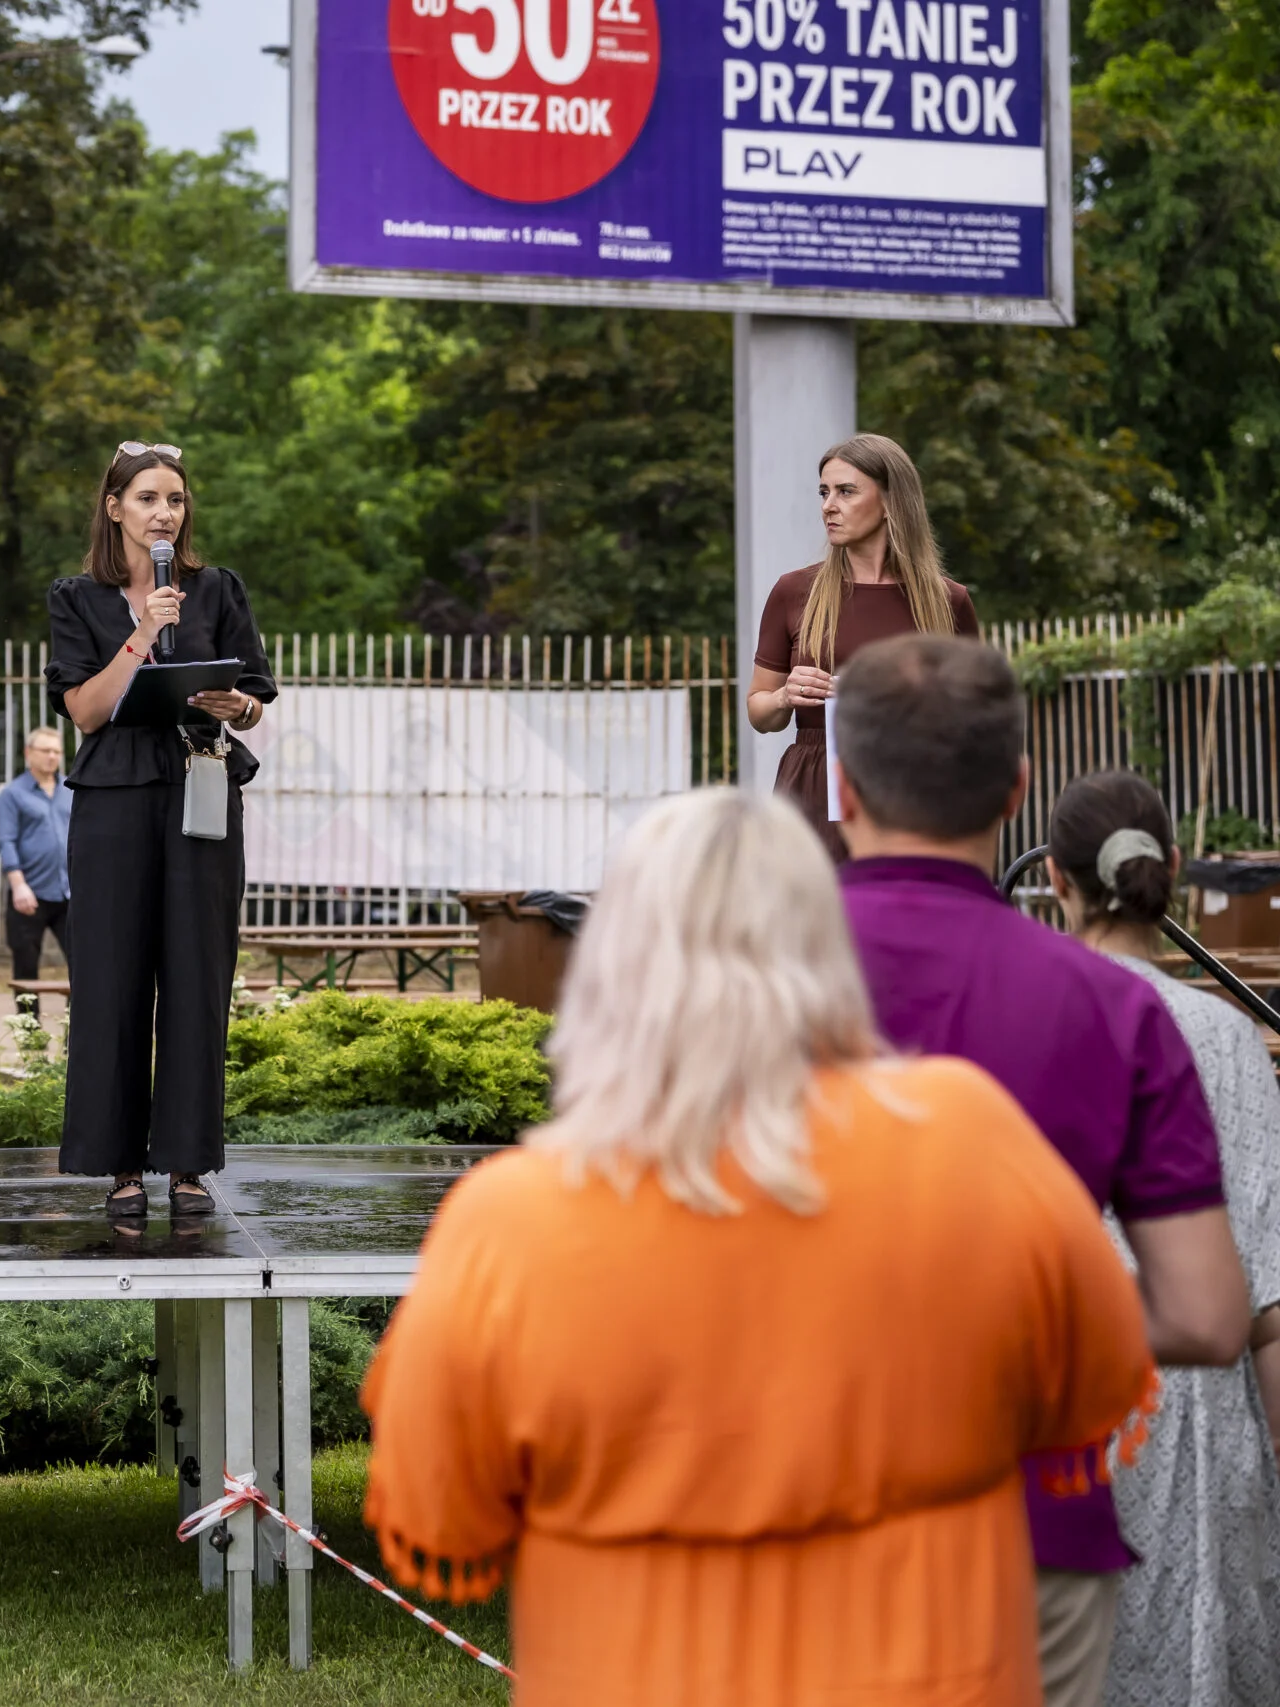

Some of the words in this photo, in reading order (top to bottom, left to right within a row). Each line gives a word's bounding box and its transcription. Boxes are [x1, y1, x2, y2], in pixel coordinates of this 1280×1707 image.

[451, 0, 595, 85] 50
[723, 0, 826, 54] 50%
[836, 0, 1017, 68] TANIEJ
[438, 88, 540, 131] PRZEZ
[546, 96, 612, 136] ROK
[723, 59, 894, 130] PRZEZ
[911, 71, 1017, 138] ROK
[743, 147, 863, 179] PLAY
